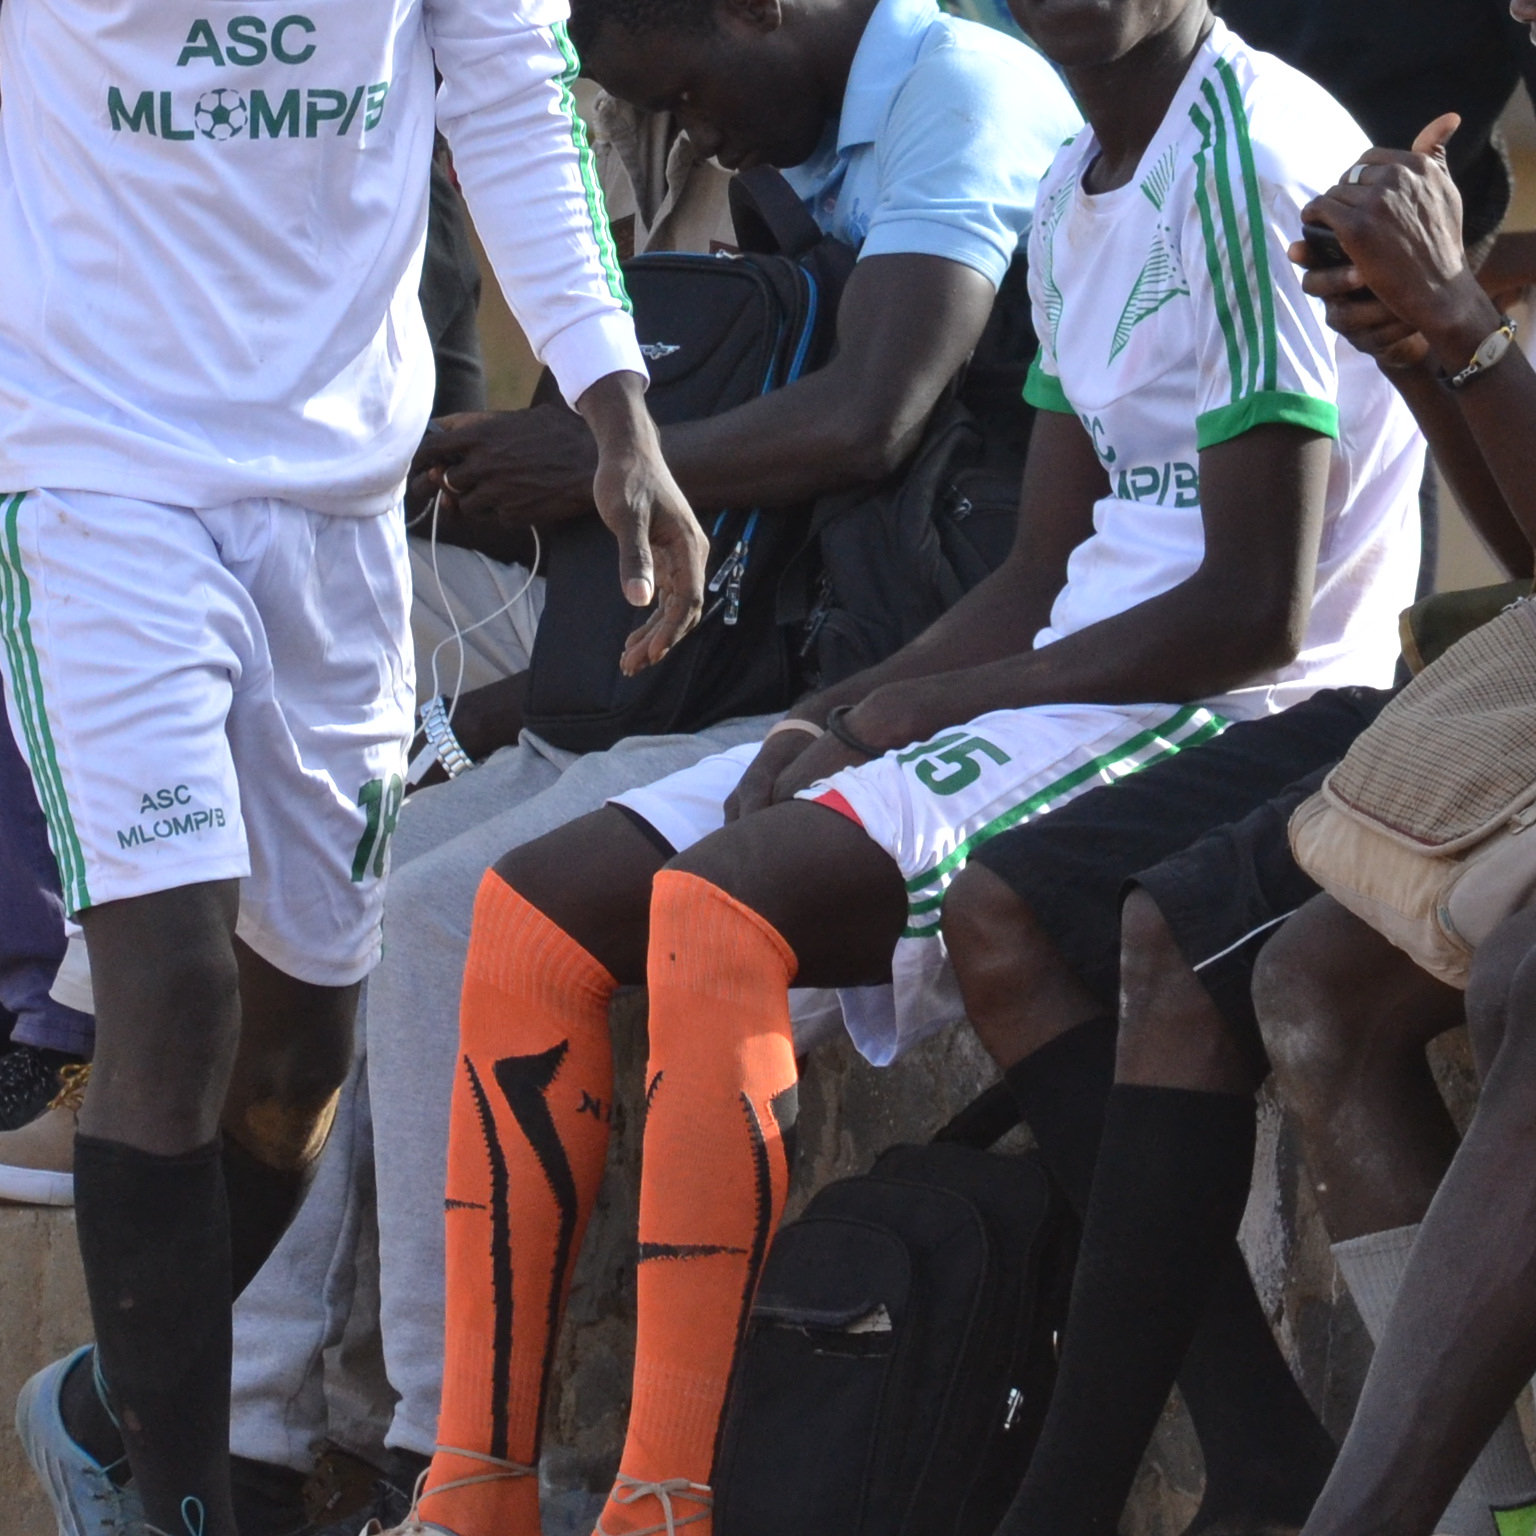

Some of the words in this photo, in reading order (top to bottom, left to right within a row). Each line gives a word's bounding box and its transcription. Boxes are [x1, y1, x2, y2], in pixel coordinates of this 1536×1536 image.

[176, 14, 317, 67] ASC
[140, 784, 192, 814] ASC
[116, 807, 226, 850] MLOMP/B
